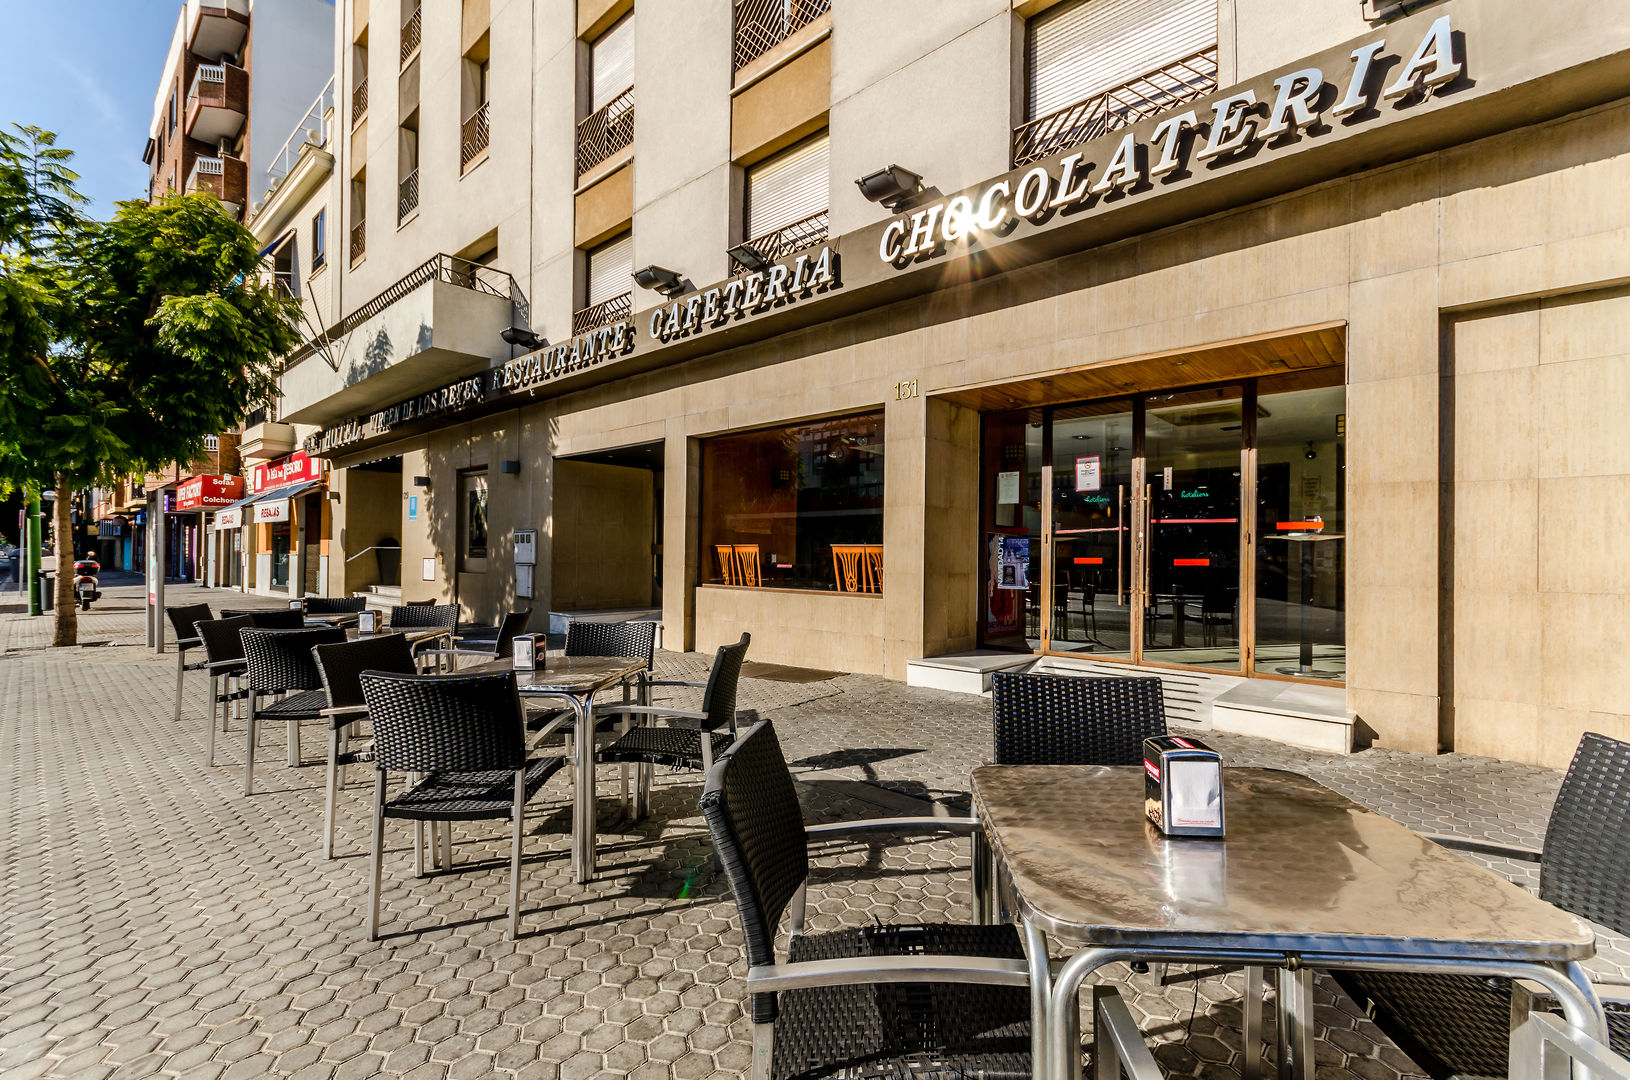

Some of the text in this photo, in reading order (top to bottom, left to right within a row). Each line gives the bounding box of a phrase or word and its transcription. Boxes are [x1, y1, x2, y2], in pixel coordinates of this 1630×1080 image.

[878, 14, 1463, 265] CHOCOLATERIA
[649, 246, 835, 340] CAFETERIA
[491, 321, 628, 390] RESTAURANTE
[894, 379, 919, 400] 131
[324, 377, 482, 450] HOTEL VIRGEN DE LOS REYES
